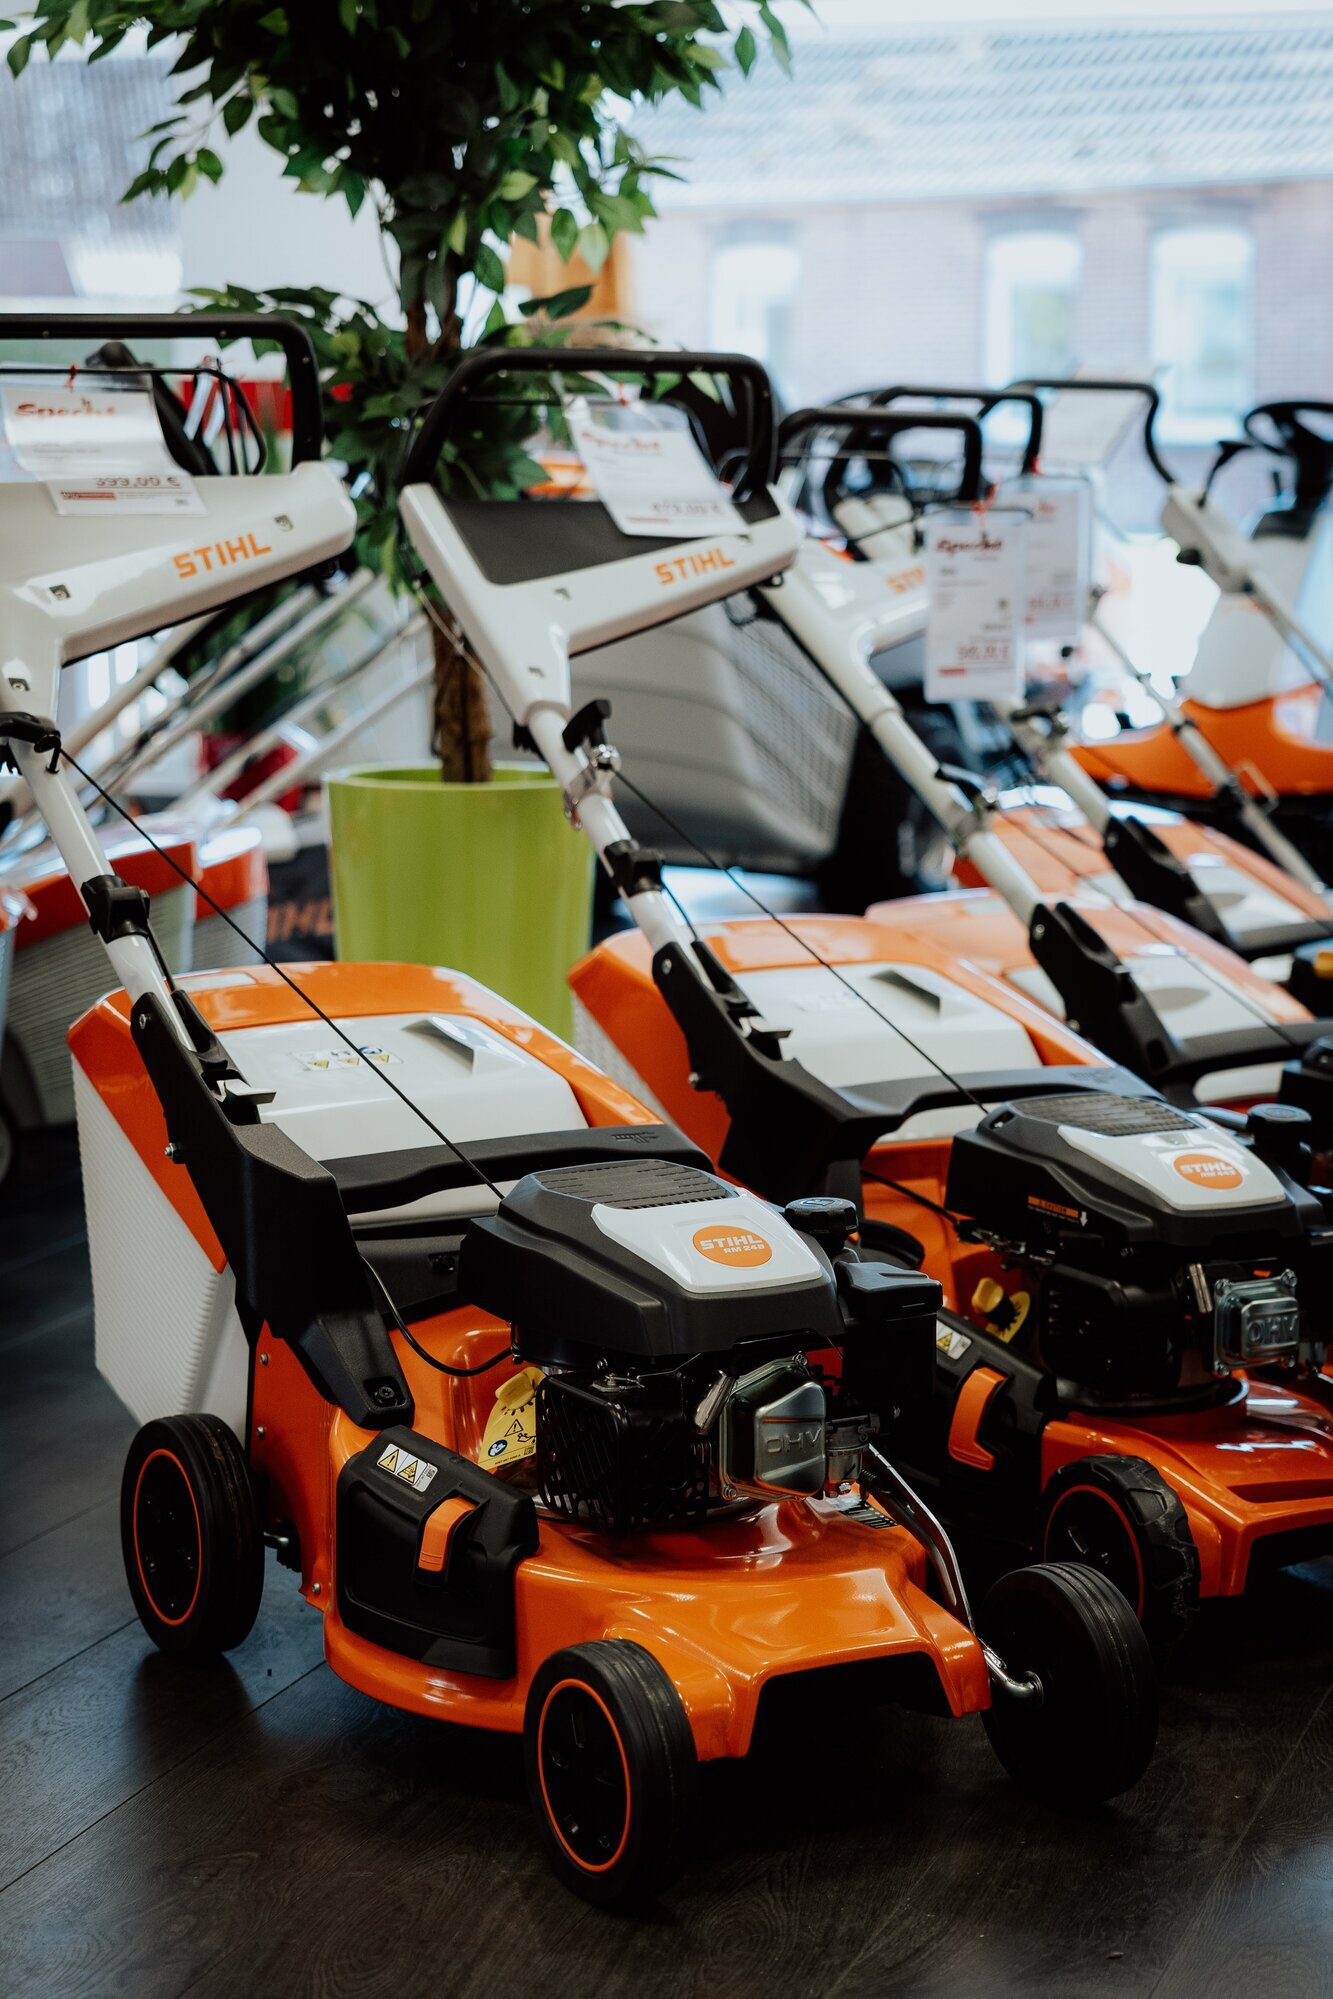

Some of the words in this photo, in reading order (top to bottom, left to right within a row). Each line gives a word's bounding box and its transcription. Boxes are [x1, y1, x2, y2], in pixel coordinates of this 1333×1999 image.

[172, 533, 272, 579] STIHL
[655, 548, 736, 586] STIHL
[1180, 1162, 1234, 1174] STIHL
[699, 1234, 763, 1251] STIHL
[1247, 1315, 1298, 1345] OHV
[765, 1424, 823, 1454] OHV
